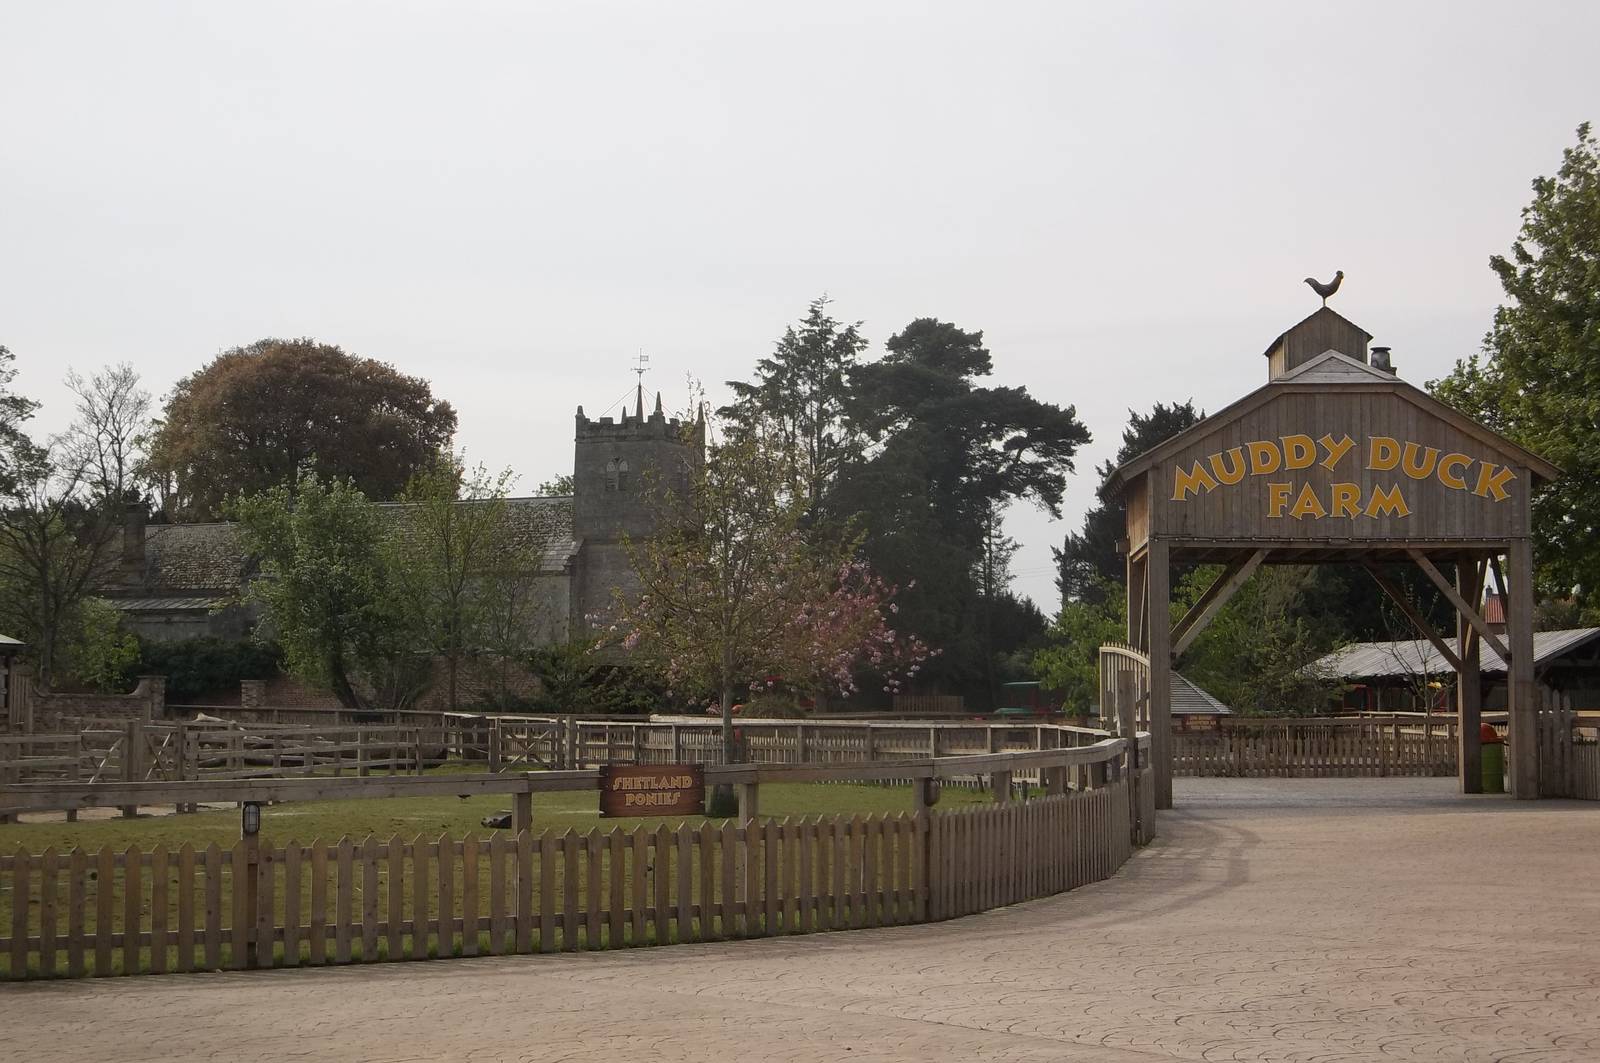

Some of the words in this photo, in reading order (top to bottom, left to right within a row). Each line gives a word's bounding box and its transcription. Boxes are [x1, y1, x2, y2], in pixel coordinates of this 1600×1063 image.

[1170, 433, 1357, 501] MUDDY
[1366, 436, 1517, 503] DUCK
[1267, 481, 1413, 520] FARM
[612, 775, 693, 791] SHETLAND
[625, 792, 681, 806] PONIES
